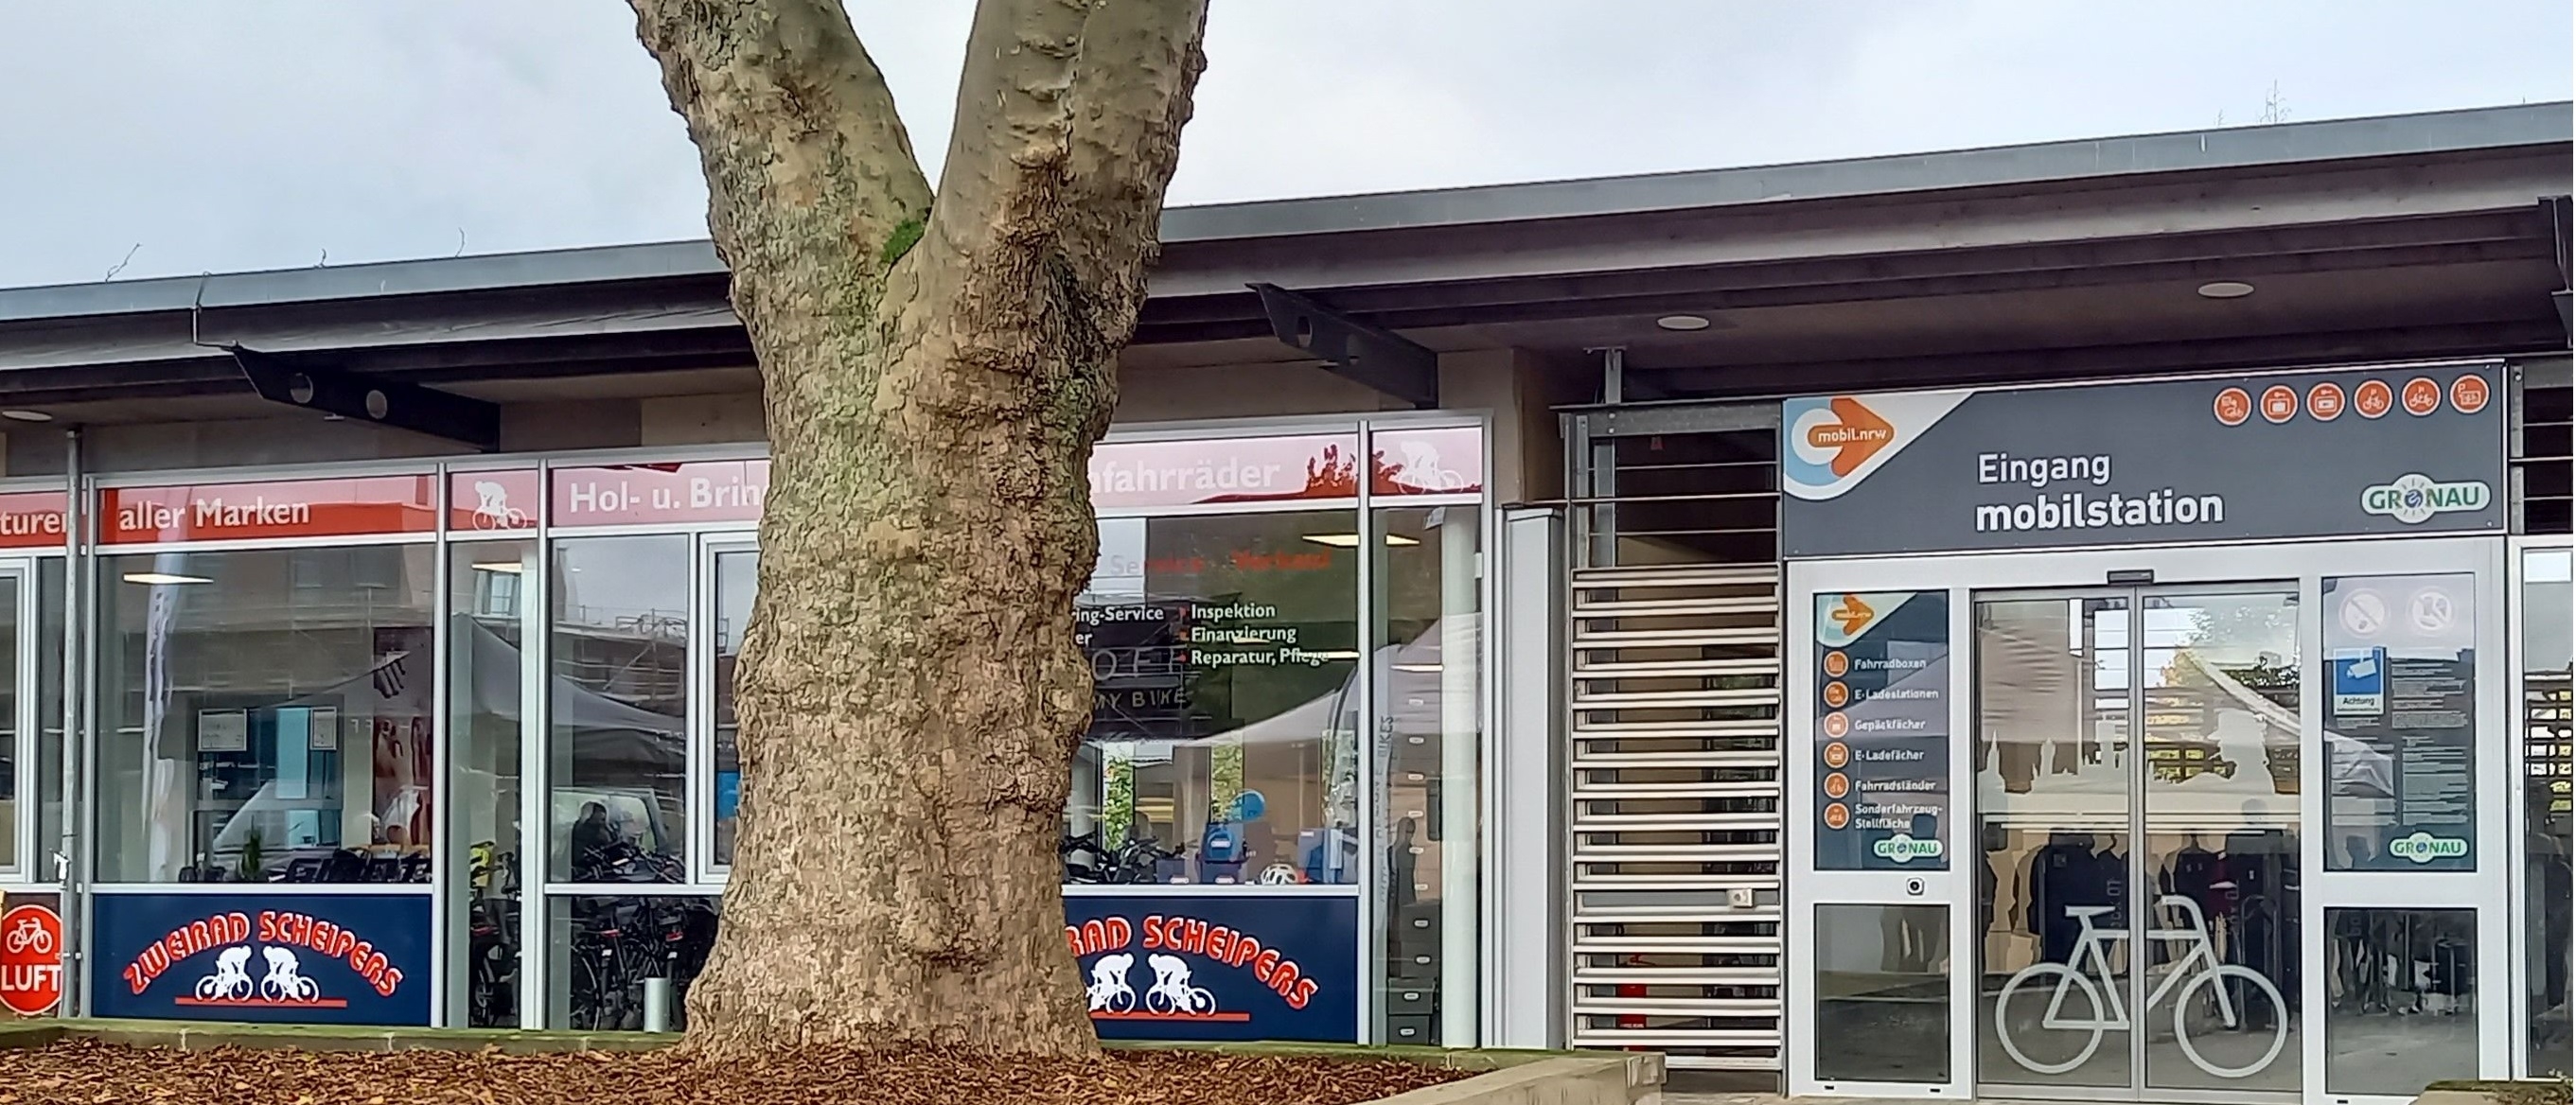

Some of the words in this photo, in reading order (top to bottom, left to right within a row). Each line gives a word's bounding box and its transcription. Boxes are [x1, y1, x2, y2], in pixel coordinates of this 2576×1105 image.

[1818, 428, 1886, 443] mobil.nrw
[1978, 453, 2110, 487] Eingang
[570, 481, 641, 513] Hol-
[652, 487, 680, 510] u.
[2369, 486, 2479, 509] GRONAU
[119, 500, 187, 531] aller
[196, 496, 310, 527] Marken
[1976, 488, 2224, 531] mobilstation
[1071, 605, 1164, 626] ing-Service
[1191, 604, 1276, 623] Inspektion
[1191, 625, 1297, 643] Finanzierung
[1191, 650, 1277, 669] Reparatur,
[1279, 647, 1330, 667] Pflege
[1855, 658, 1927, 671] Fahrradboxen
[2342, 697, 2375, 706] Achtung
[1878, 842, 1937, 853] GRONAU
[2394, 841, 2461, 852] GRONAU
[123, 912, 251, 995] ZWEIRAD
[258, 910, 404, 997] SCHEIPERS
[1143, 915, 1319, 1009] SCHEIPERS
[1, 965, 62, 991] LUFT
